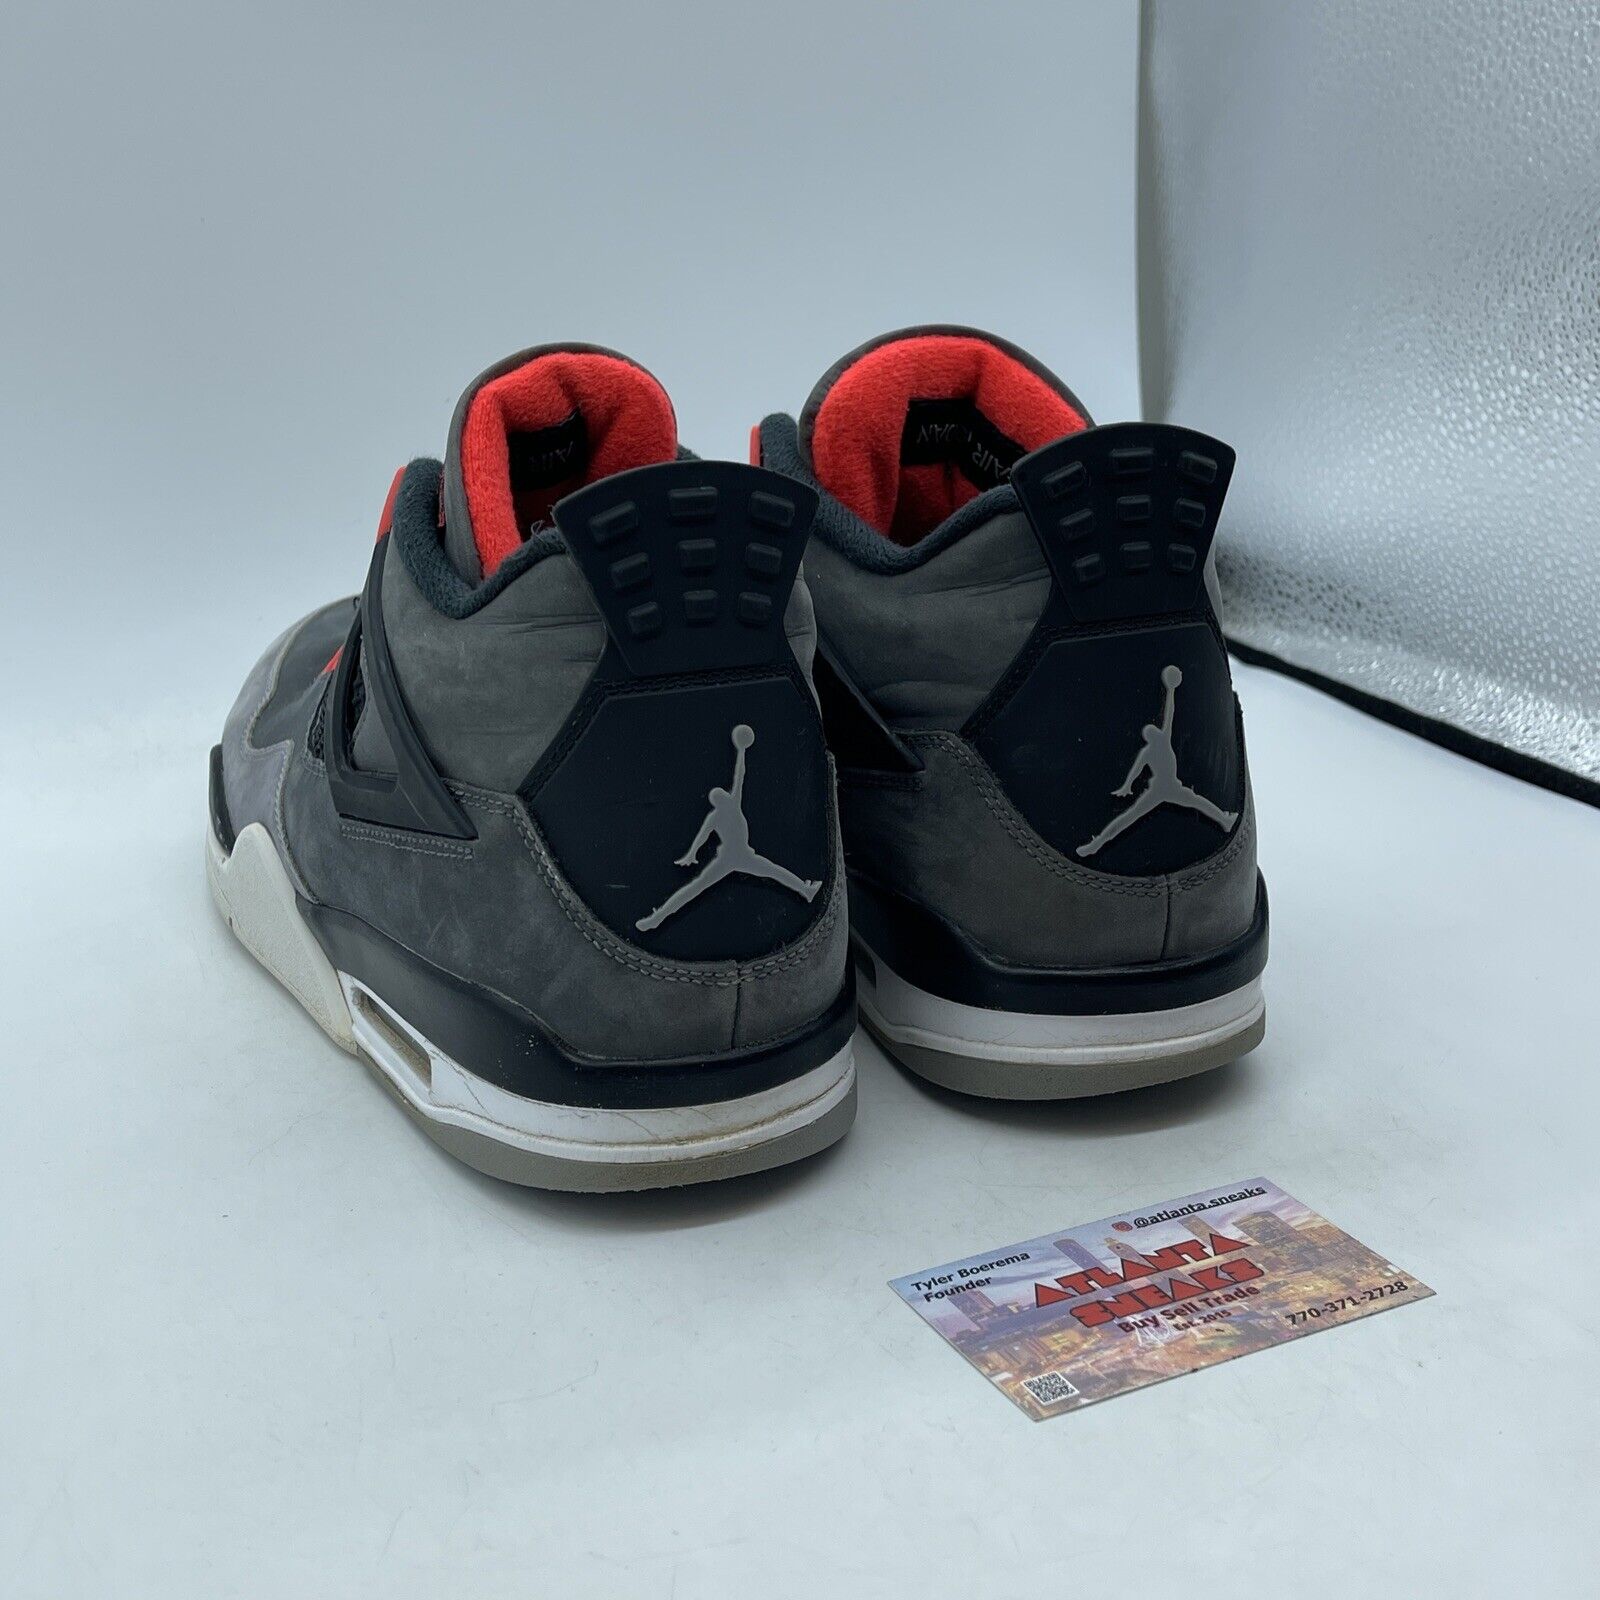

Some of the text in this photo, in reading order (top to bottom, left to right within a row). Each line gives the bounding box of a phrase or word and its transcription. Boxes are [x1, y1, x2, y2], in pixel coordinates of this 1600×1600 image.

[1133, 1185, 1267, 1228] @atlanta.sneaks
[911, 1252, 1031, 1291] Tyler Boerema
[923, 1276, 992, 1303] Founder
[1034, 1233, 1251, 1308] ATLANTA
[1069, 1257, 1265, 1328] SNEAKS
[1117, 1286, 1260, 1333] Buy Sell Trade
[1172, 1309, 1232, 1332] Est. 2015
[1285, 1281, 1409, 1326] 770-371-2728
